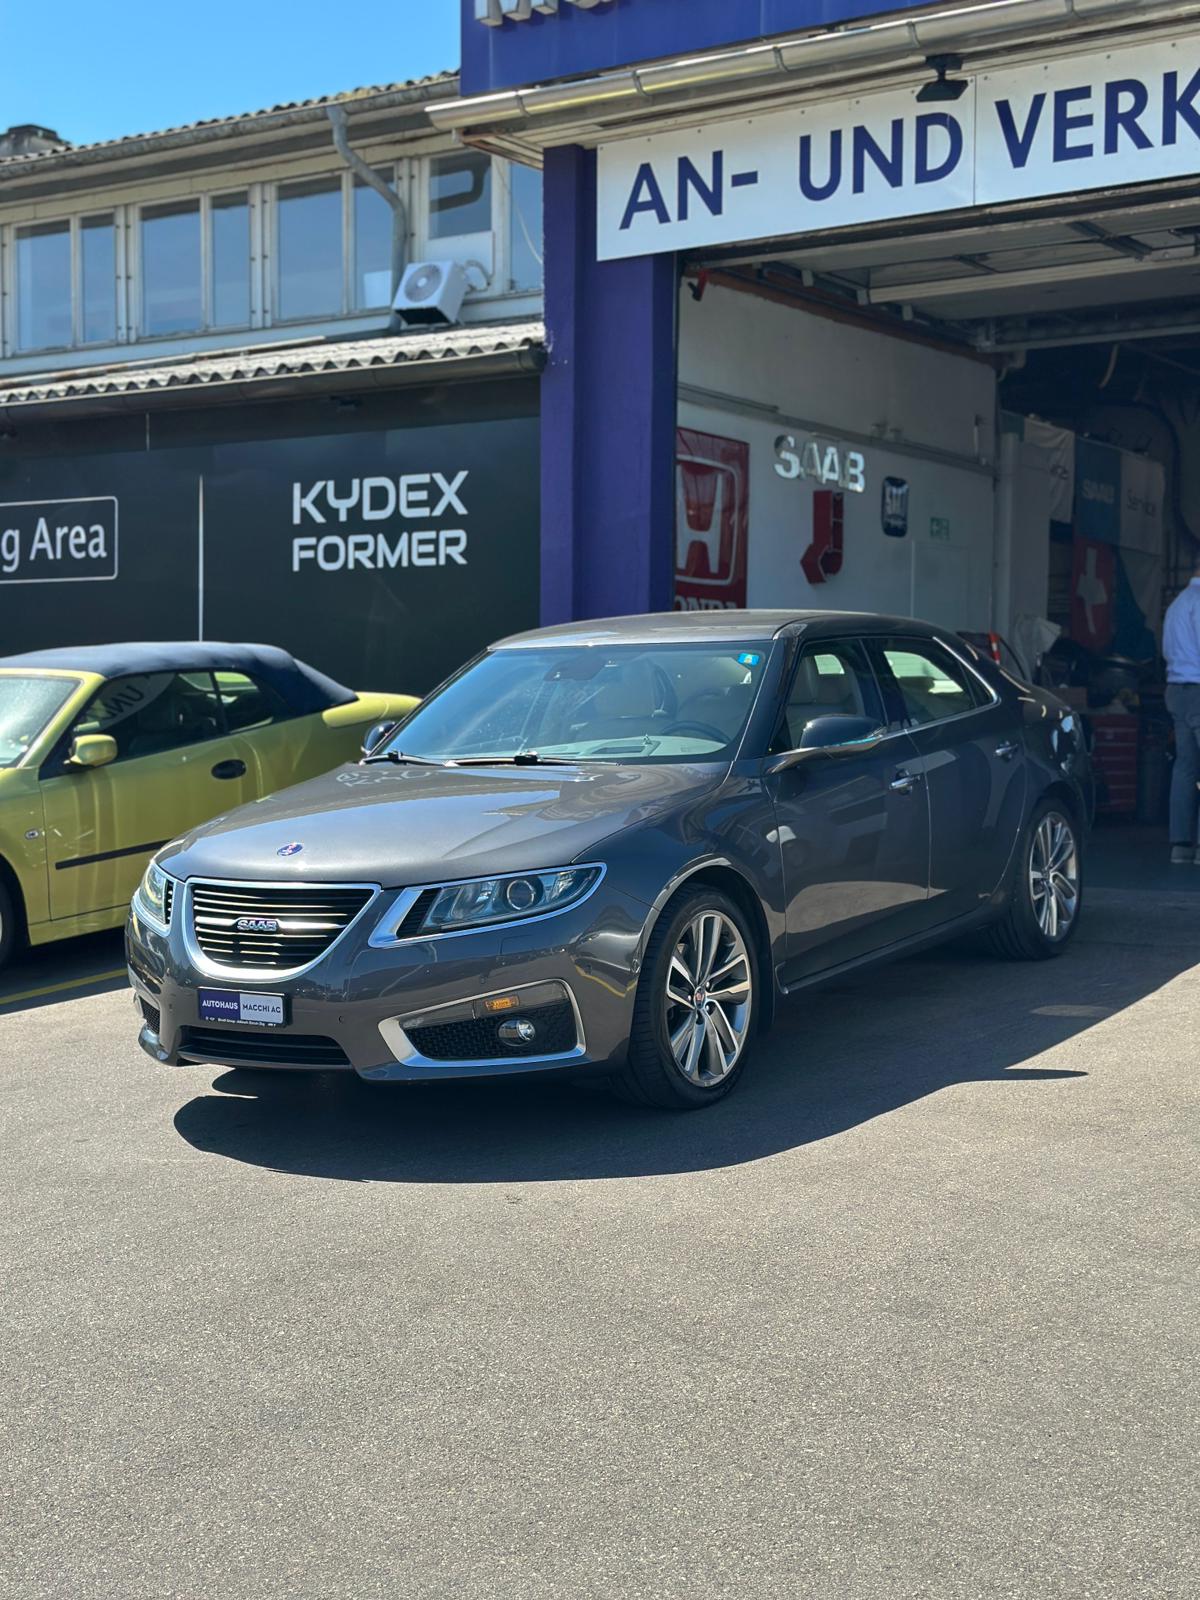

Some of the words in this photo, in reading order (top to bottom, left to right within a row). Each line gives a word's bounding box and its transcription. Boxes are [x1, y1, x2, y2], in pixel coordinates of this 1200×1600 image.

[619, 150, 758, 230] AN-
[799, 112, 963, 202] UND
[994, 67, 1200, 169] VERK
[774, 435, 865, 493] SAAB
[293, 471, 468, 524] KYDEX
[29, 517, 107, 560] Area
[293, 529, 467, 571] FORMER
[237, 919, 277, 931] SAAB
[202, 1000, 239, 1010] AUTOHAUS
[242, 1004, 270, 1013] MACCHI
